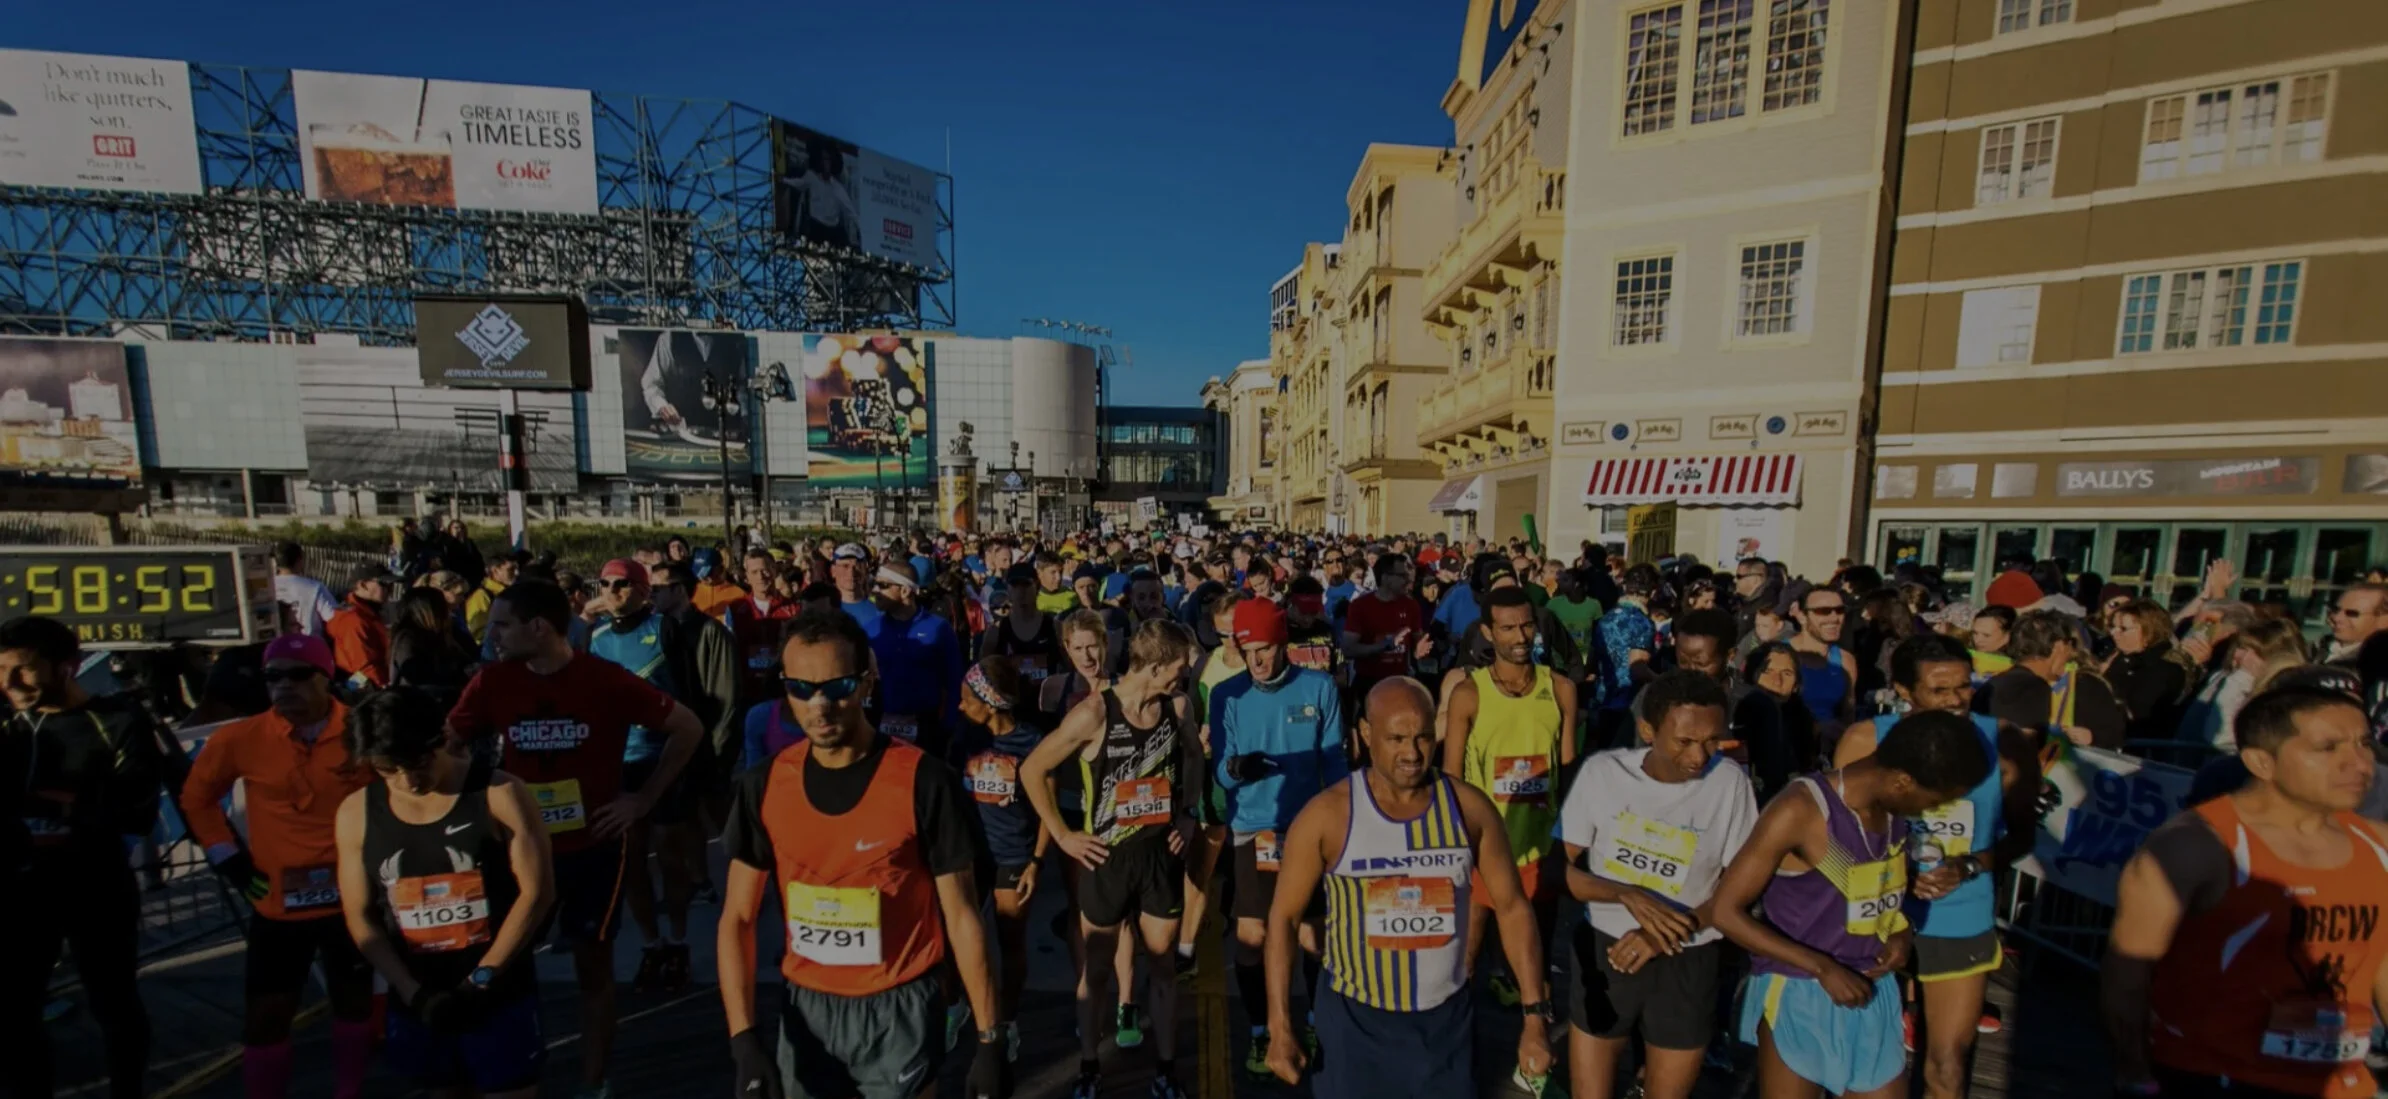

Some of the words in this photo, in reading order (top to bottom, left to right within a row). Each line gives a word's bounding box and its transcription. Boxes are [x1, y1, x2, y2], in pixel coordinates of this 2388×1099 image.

[106, 66, 164, 88] much
[43, 82, 79, 102] like
[86, 92, 172, 111] quitters,
[459, 103, 513, 122] GREAT
[517, 107, 560, 126] TASTE
[565, 110, 580, 128] IS
[462, 121, 582, 151] TIMELESS
[496, 159, 551, 181] Coke
[2067, 468, 2154, 490] BALLY'S
[2213, 464, 2300, 493] BAR
[68, 624, 144, 641] NISH
[508, 722, 590, 743] CHICAGO
[521, 740, 576, 751] MARATHON
[1502, 780, 1544, 794] 1825
[2093, 769, 2168, 830] 95
[1615, 847, 1678, 878] 2618
[411, 903, 474, 926] 1103
[1378, 916, 1444, 934] 1002
[799, 924, 865, 948] 2791
